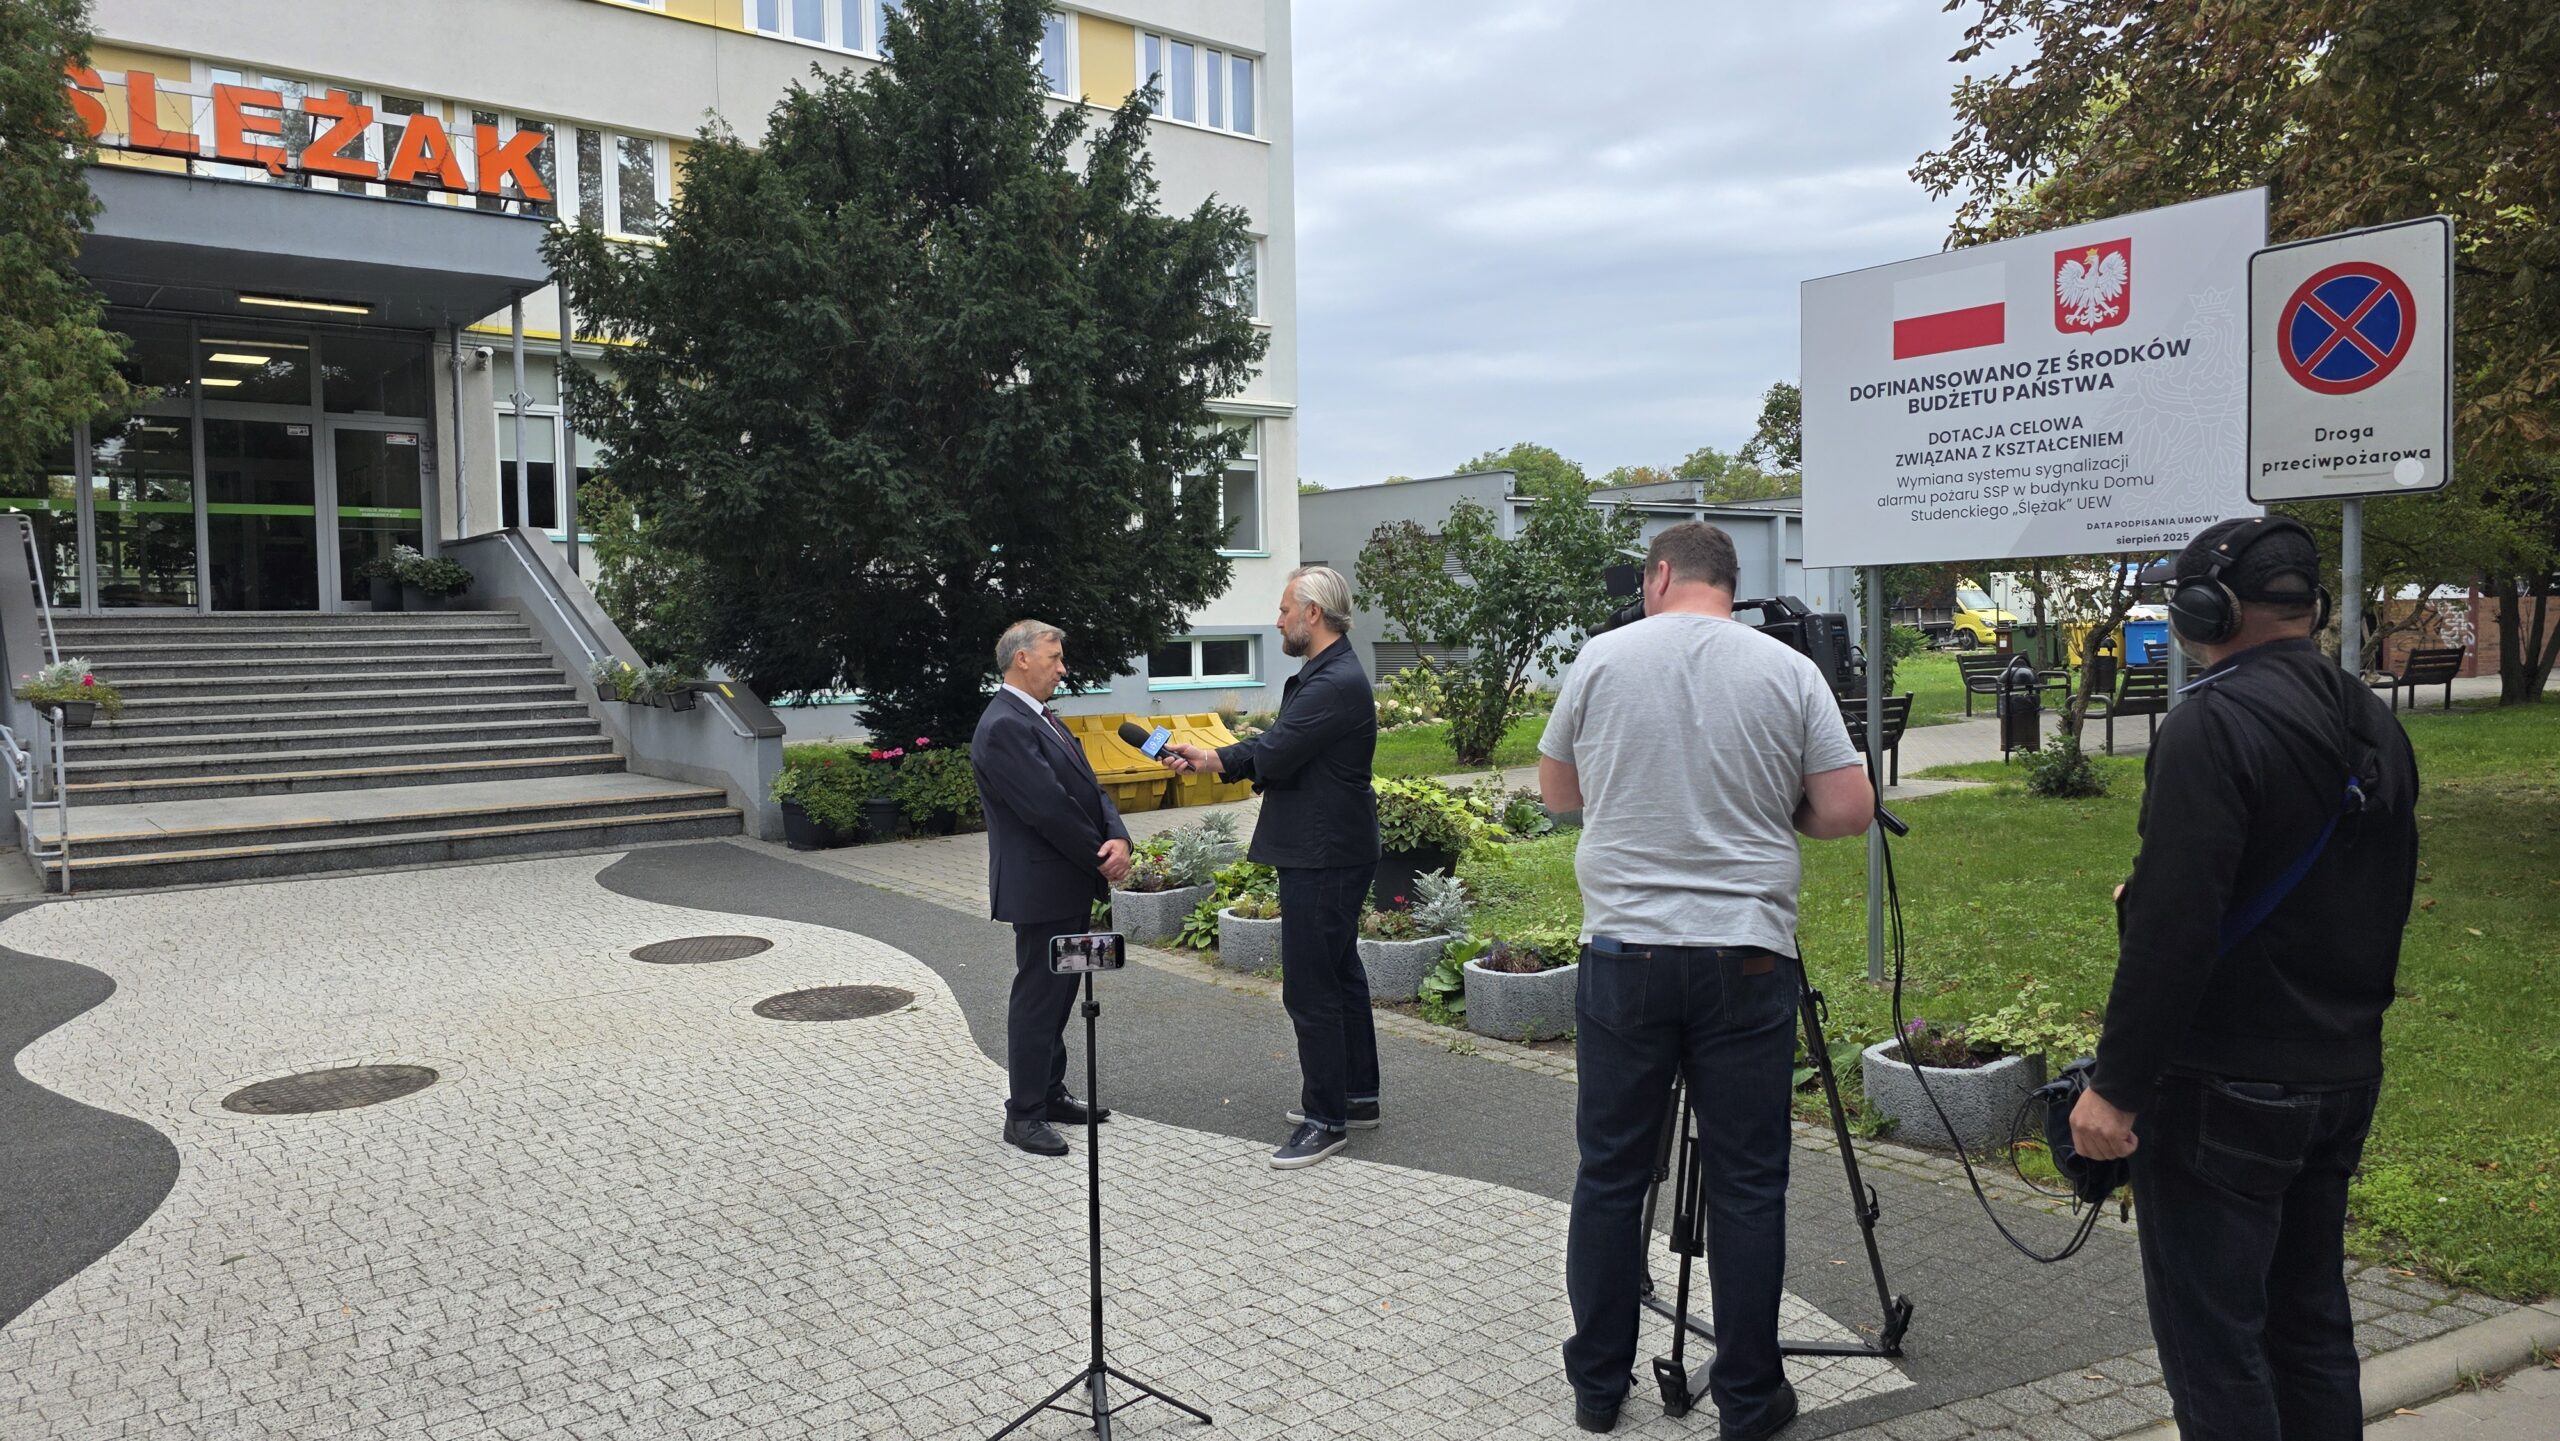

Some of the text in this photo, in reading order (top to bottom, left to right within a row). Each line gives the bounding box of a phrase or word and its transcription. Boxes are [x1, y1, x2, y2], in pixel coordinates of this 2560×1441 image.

[1850, 337, 2191, 402] DOFINANSOWANO ZE ŚRODKÓW
[1908, 372, 2114, 414] BUDŻETU PAŃSTWA
[1929, 415, 2083, 445] DOTACJA CELOWA
[2315, 426, 2374, 443] Droga
[1896, 430, 2123, 467] ZWIĄZANA Z KSZTAŁCENIEM
[2262, 448, 2431, 476] przeciwpożarowa
[1897, 454, 2129, 491] Wymiana systemu sygnalizacji
[1877, 474, 2154, 507] alarmu pożaru SSP w budynku Domu
[1911, 504, 2009, 521] Studenckiego
[2077, 495, 2112, 510] UEW
[2086, 514, 2219, 531] DATA PODPISANIA UMOWY
[2116, 532, 2190, 546] sierpień 2025
